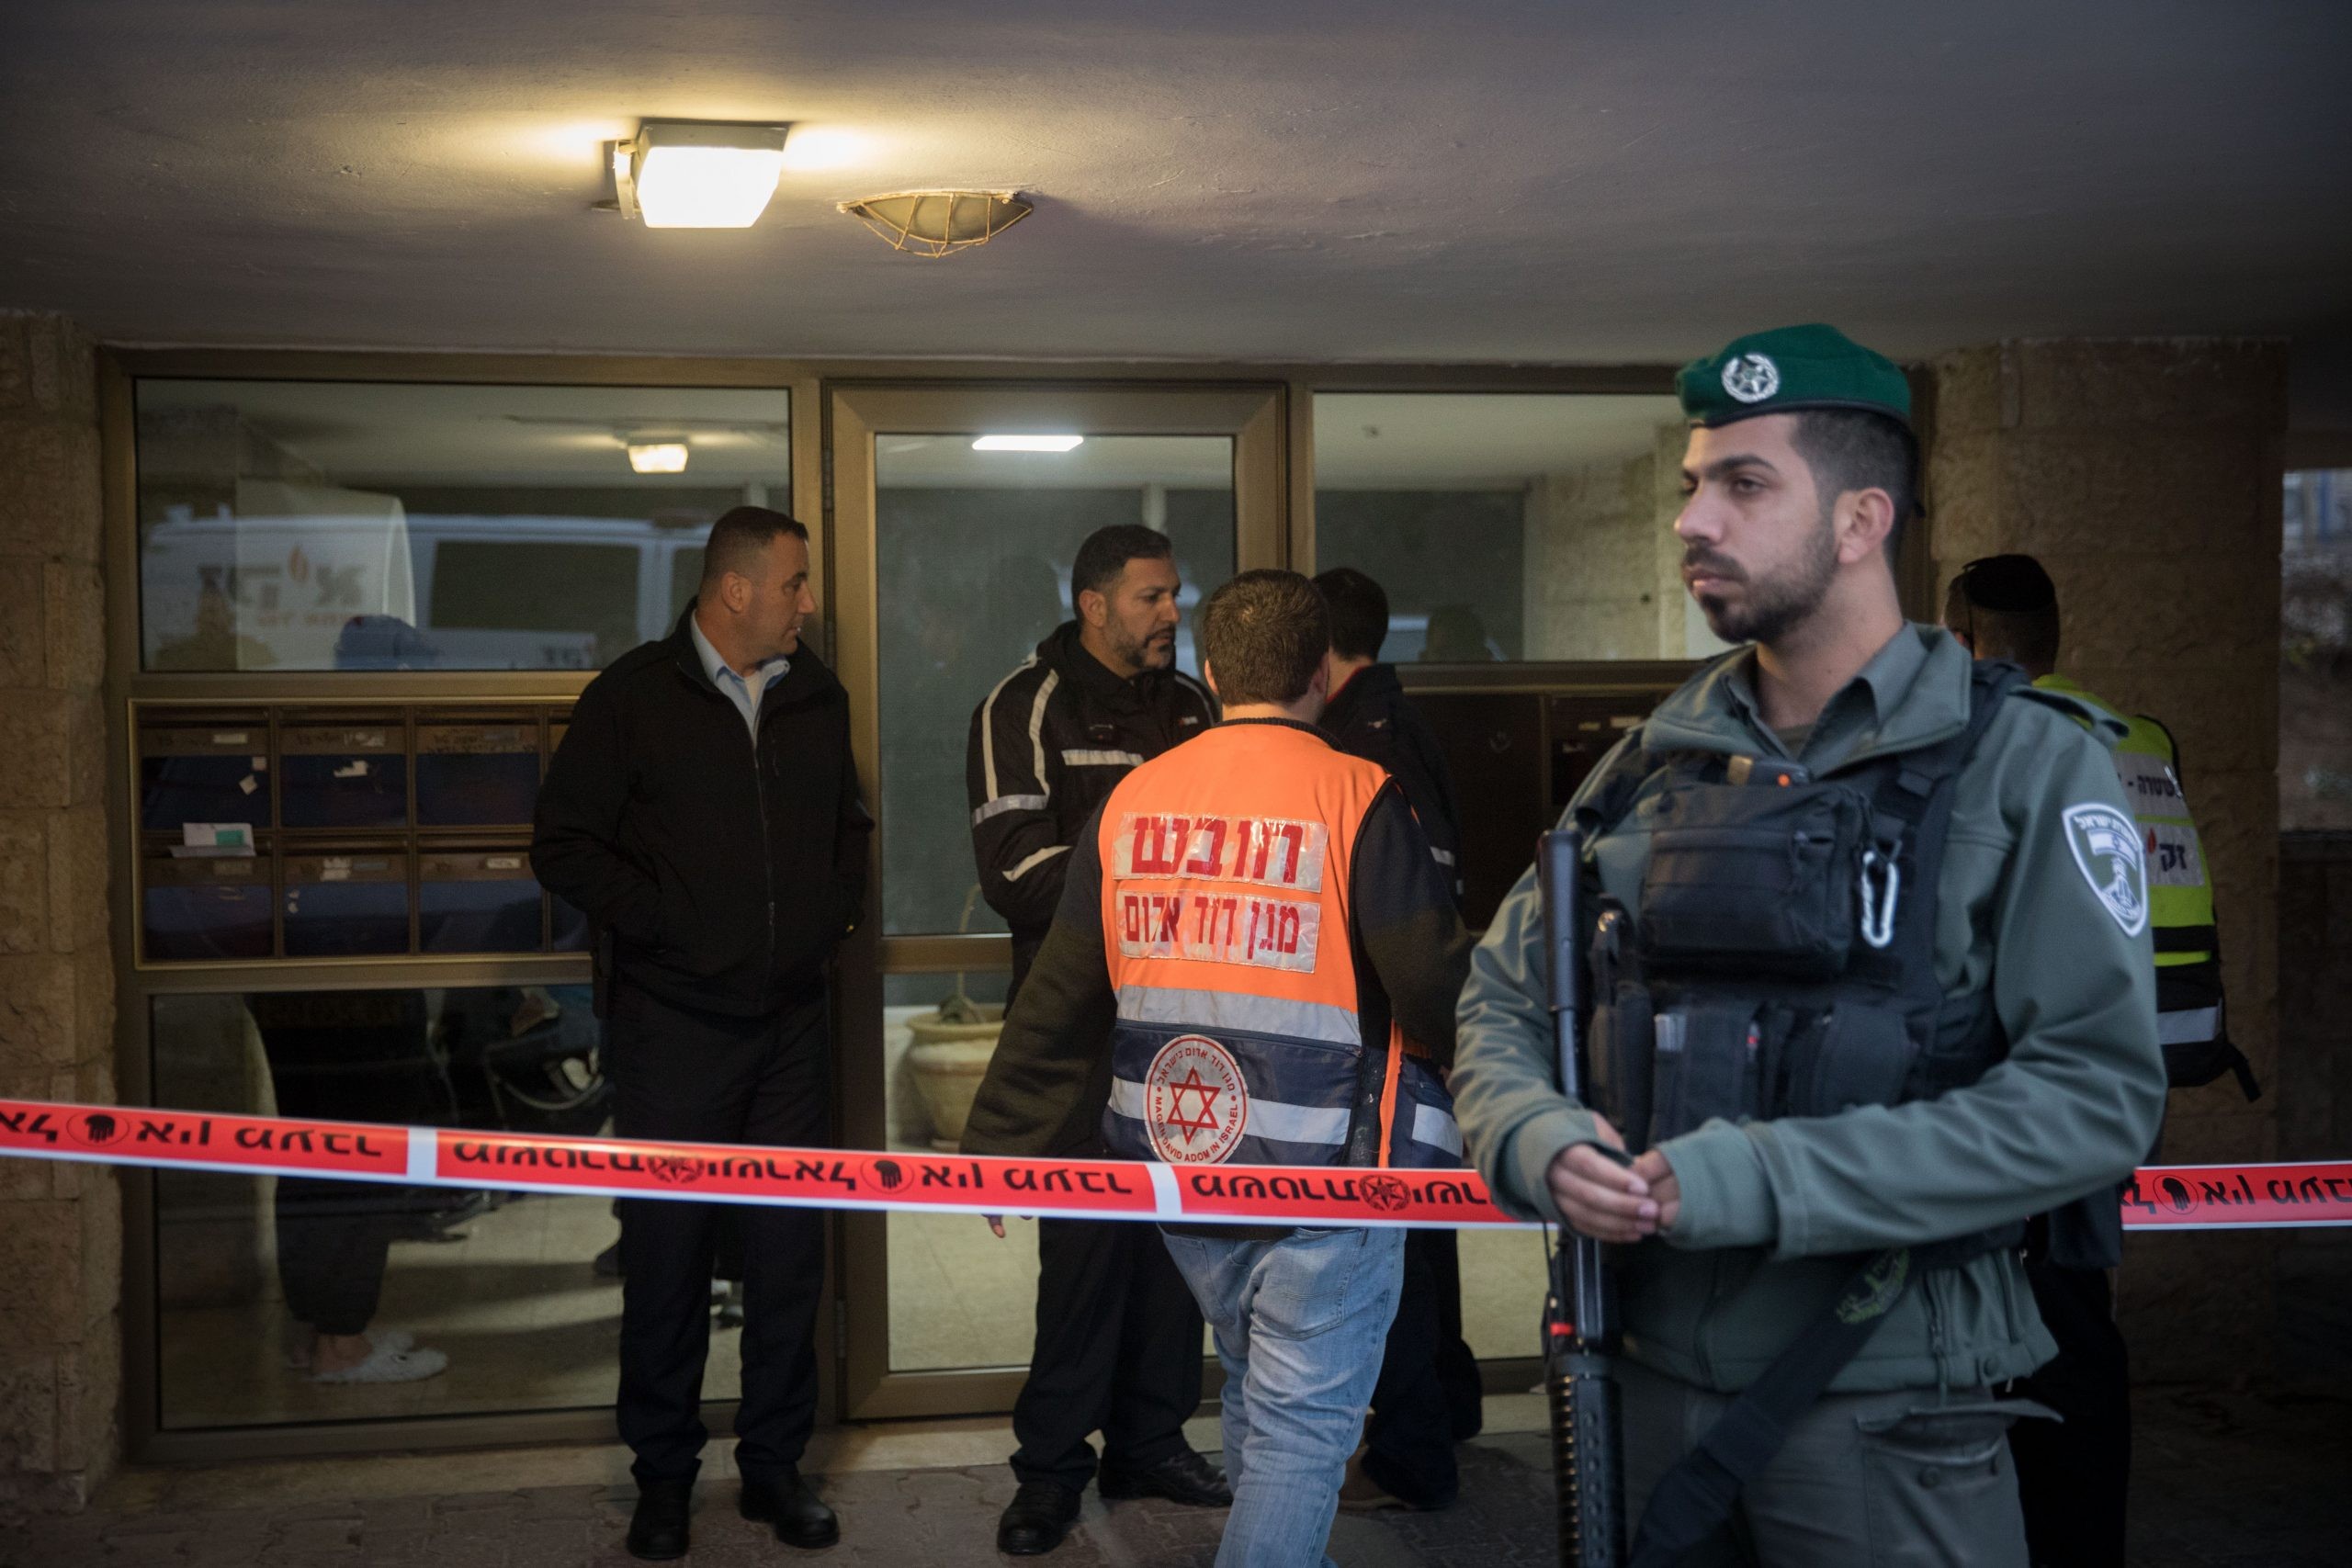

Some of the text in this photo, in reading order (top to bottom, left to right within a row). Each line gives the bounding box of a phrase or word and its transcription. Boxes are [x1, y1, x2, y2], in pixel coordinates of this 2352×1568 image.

[1131, 817, 1303, 884] חובש
[2159, 842, 2187, 872] זק
[1124, 896, 1300, 960] מגן דוד אדום
[1157, 1050, 1184, 1084] בישראל
[1185, 1048, 1208, 1060] אדום
[1211, 1055, 1226, 1072] דוד
[136, 1120, 211, 1145] אין
[1155, 1096, 1238, 1162] MAGEN DAVID ADOM IN ISRAEL
[922, 1163, 984, 1189] אין
[2198, 1174, 2352, 1205] אין מעב
[1412, 1180, 1489, 1204] ישר
